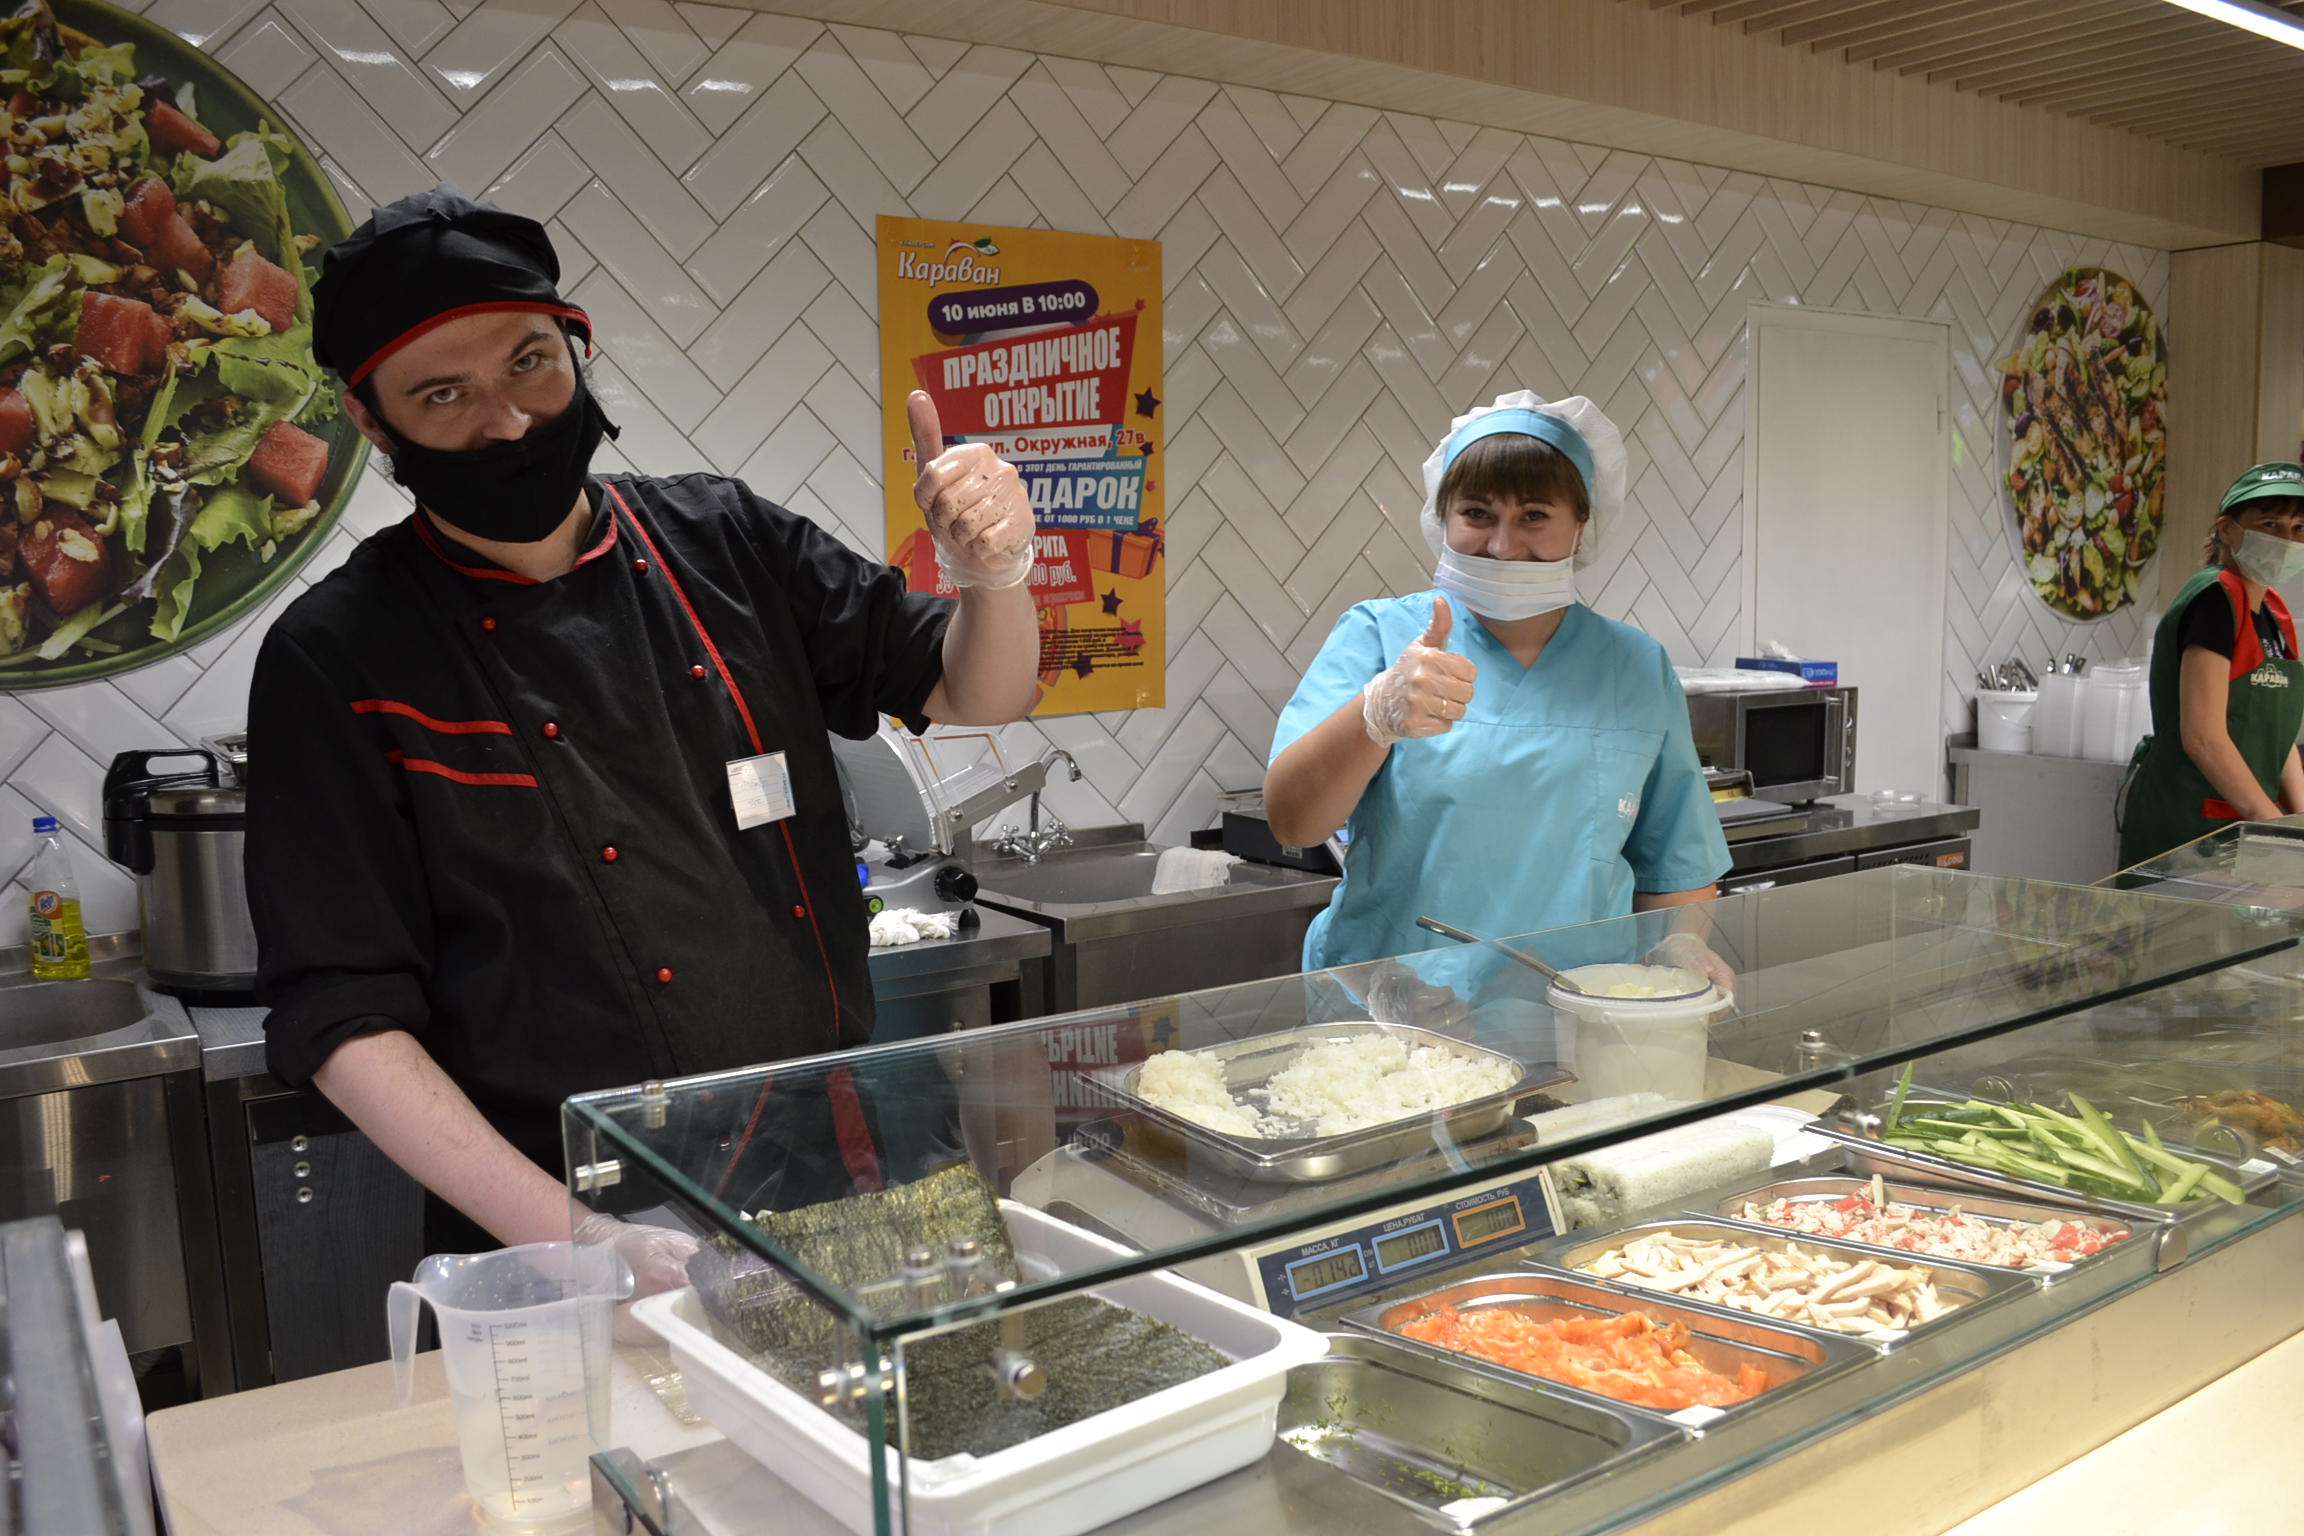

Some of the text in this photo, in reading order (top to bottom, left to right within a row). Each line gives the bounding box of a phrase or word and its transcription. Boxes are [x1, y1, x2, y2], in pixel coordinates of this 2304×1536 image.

[897, 250, 1000, 288] Караван
[942, 291, 1086, 322] 10 июня В 10:00
[943, 326, 1121, 390] ПРАЗДНИЧНОЕ
[984, 377, 1100, 428] ОТКРЫТИЕ
[1014, 435, 1112, 455] Окружная,
[1117, 430, 1145, 446] 27в
[1025, 463, 1044, 472] ЭТОТ
[1045, 462, 1066, 473] ДЕНЬ
[1068, 459, 1142, 471] ГАРАНТИРОВАННЫЙ
[1020, 476, 1140, 514] ДАРОК
[1044, 515, 1055, 523] ОТ
[1057, 515, 1078, 524] 1000
[1080, 515, 1096, 524] РУБ
[1033, 535, 1069, 558] РИТА
[1049, 560, 1078, 587] руб.
